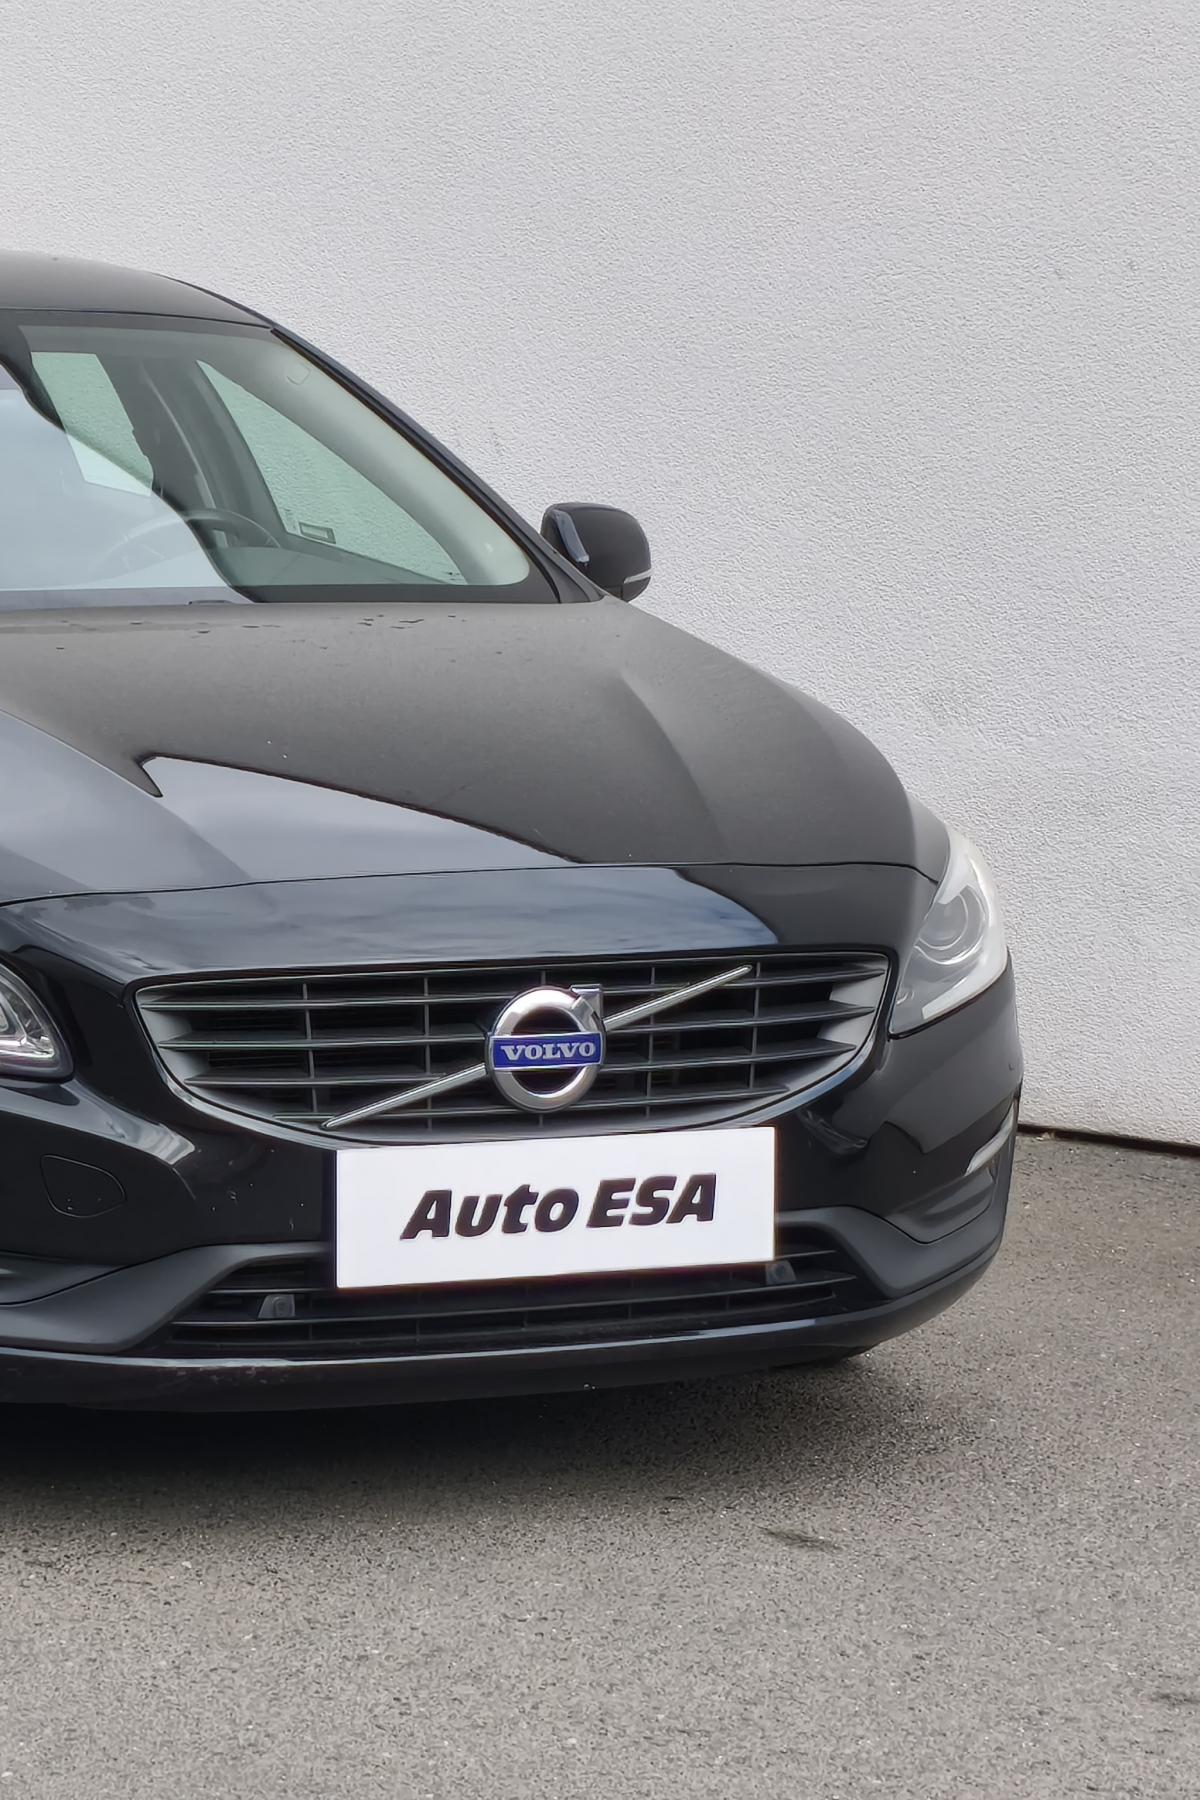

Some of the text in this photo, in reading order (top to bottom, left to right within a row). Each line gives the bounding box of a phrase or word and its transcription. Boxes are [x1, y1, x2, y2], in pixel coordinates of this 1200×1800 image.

[500, 1042, 596, 1061] VOLVO
[400, 1173, 717, 1240] Auto ESA
